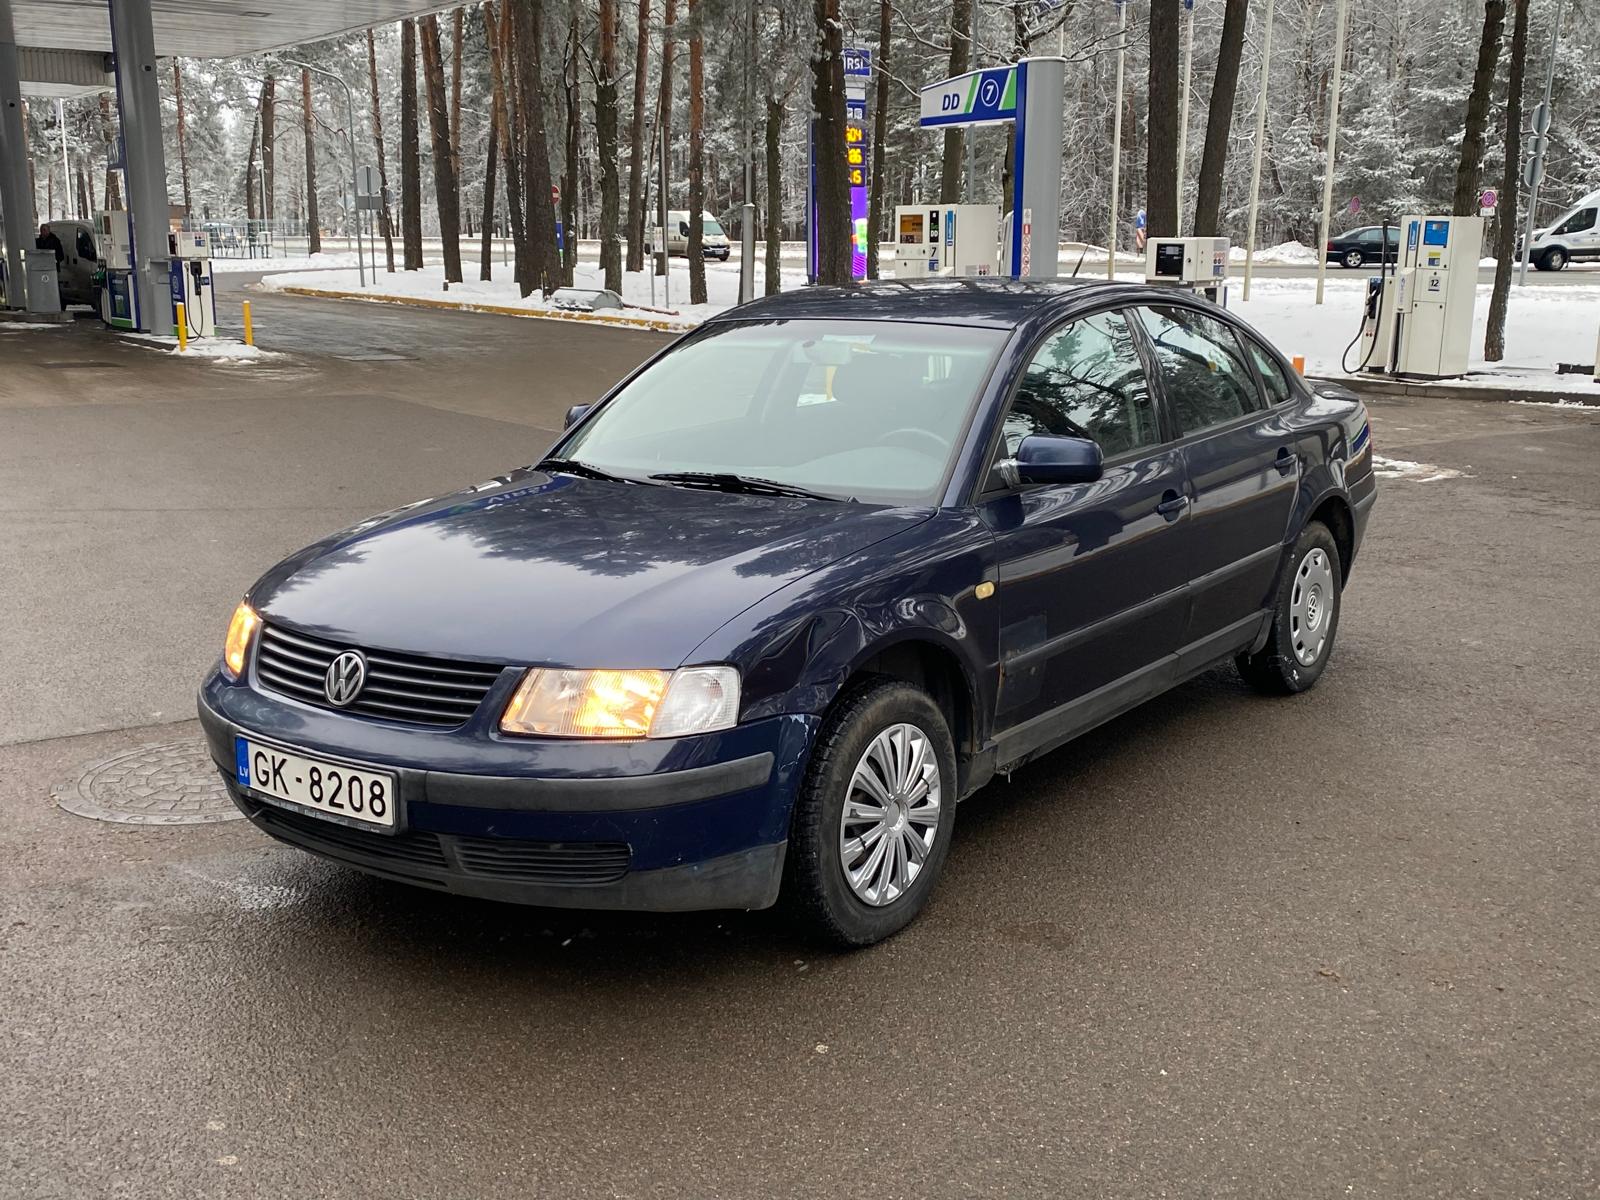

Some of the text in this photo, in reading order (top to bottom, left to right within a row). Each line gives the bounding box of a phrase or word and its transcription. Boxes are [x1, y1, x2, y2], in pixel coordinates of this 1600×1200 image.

[942, 85, 994, 111] DD 7
[931, 246, 937, 257] 7
[1431, 279, 1439, 287] 12
[239, 765, 249, 778] LV
[254, 750, 387, 818] GK-8208
